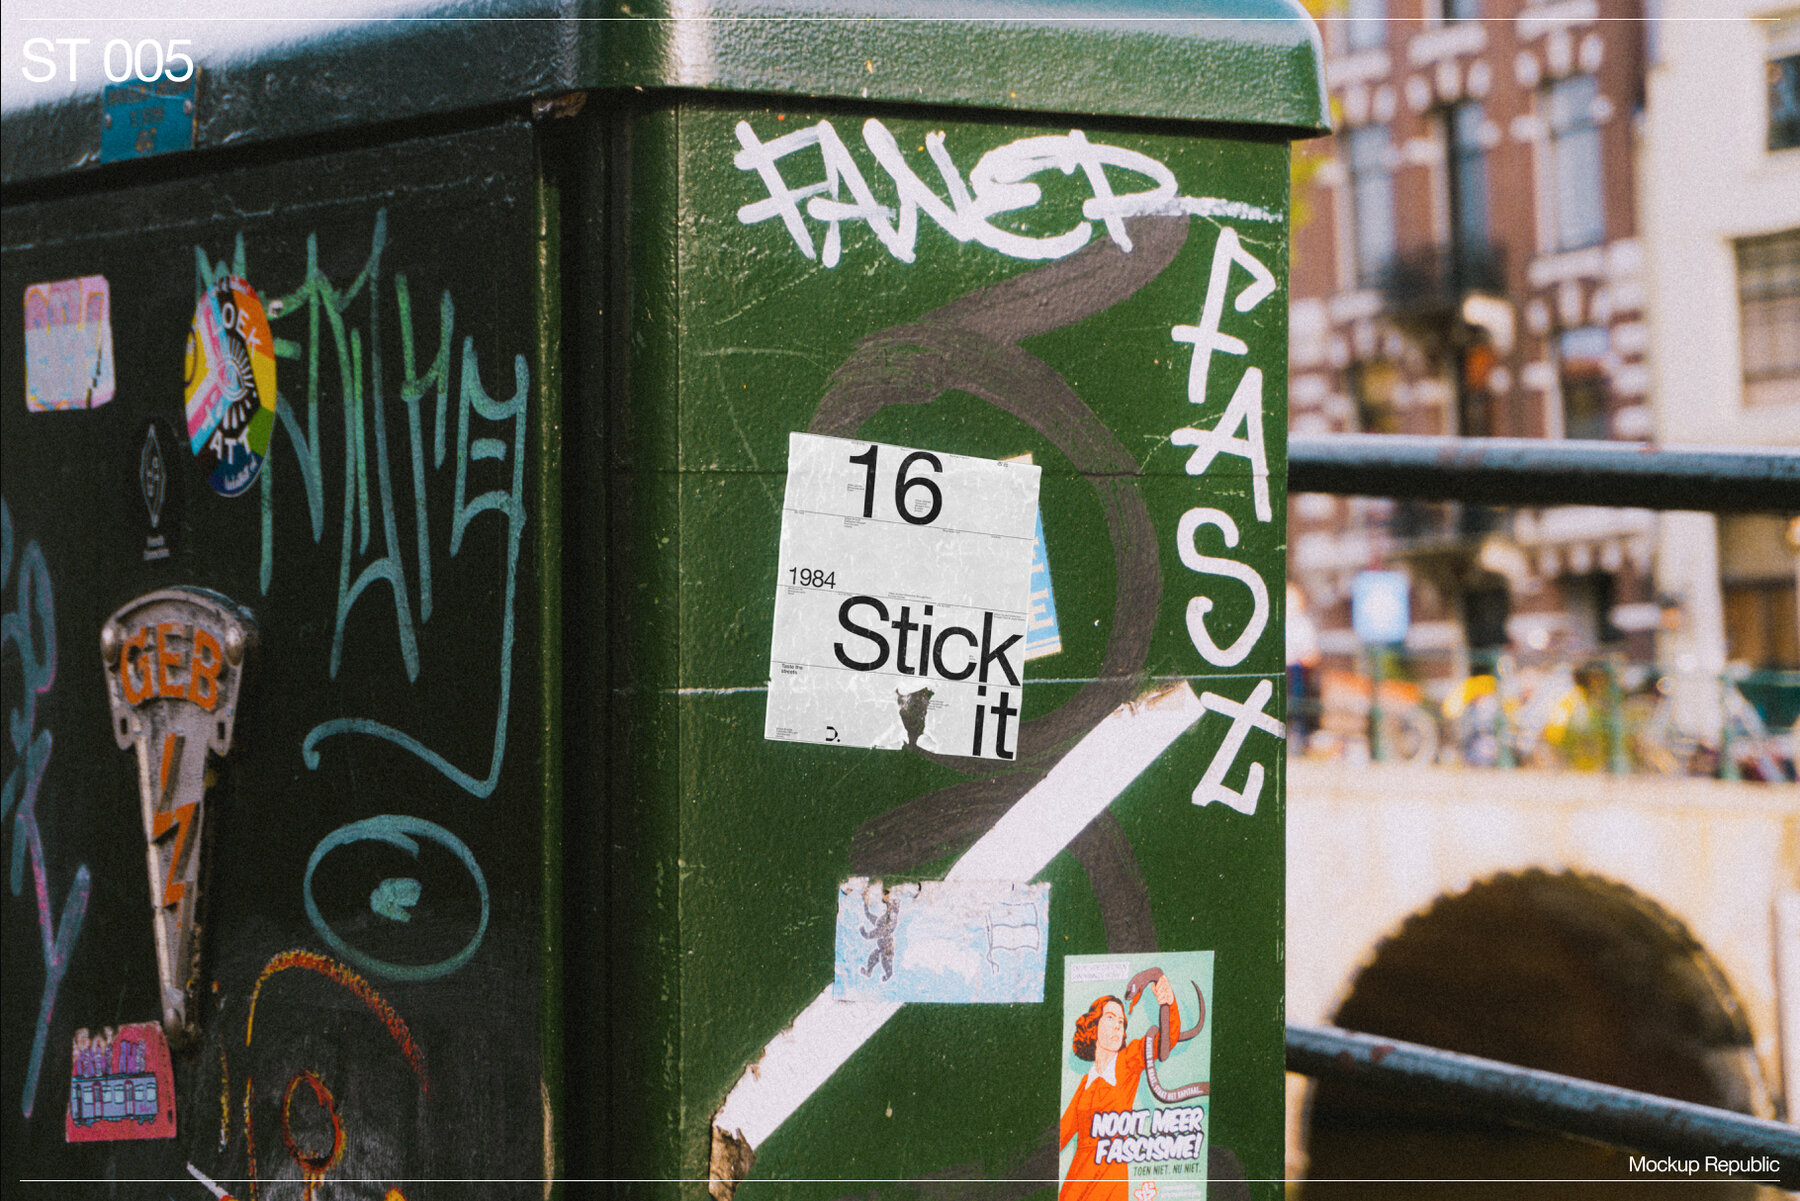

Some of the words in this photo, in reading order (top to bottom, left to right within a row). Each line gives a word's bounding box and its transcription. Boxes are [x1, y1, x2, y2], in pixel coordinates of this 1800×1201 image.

[849, 445, 943, 526] 16
[789, 566, 837, 590] 1984
[120, 621, 223, 713] GEB
[833, 595, 1025, 687] Stick
[972, 684, 1018, 760] it
[1091, 1109, 1150, 1138] NOOIT
[1151, 1106, 1204, 1134] MEER
[1095, 1132, 1204, 1164] FASCISME!
[1133, 1165, 1151, 1177] TOEN
[1153, 1164, 1171, 1175] NIET.
[1173, 1164, 1183, 1174] NU
